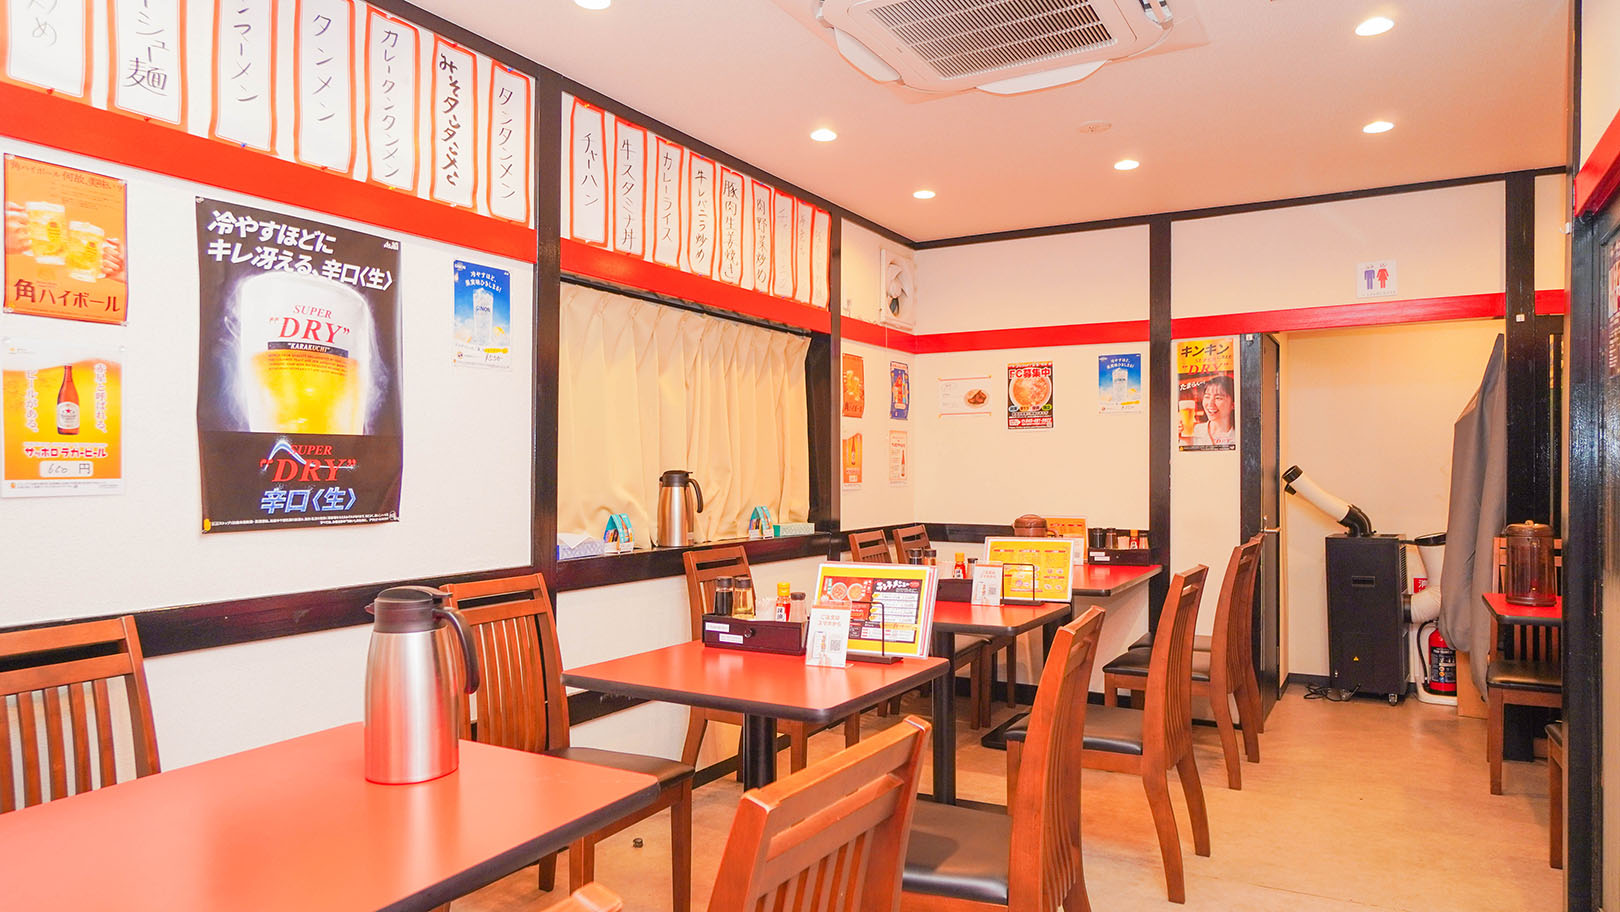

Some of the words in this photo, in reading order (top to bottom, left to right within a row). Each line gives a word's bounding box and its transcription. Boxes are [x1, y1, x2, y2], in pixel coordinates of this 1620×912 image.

[313, 14, 336, 122] タンメン
[439, 53, 461, 186] みそタンタンメン
[498, 87, 516, 199] タンタンメン
[580, 132, 599, 207] チャーハン
[619, 139, 637, 250] 牛スタミナ丼
[661, 152, 673, 242] カレーライス
[207, 209, 337, 254] 冷やすほどに
[207, 239, 393, 291] キレ冴える、辛口〈生〉
[14, 279, 121, 312] 角ハイボール
[293, 304, 333, 319] SUPER
[1181, 344, 1229, 357] キンキン
[1009, 367, 1050, 379] FC募集中
[25, 447, 58, 458] サッポロ
[61, 447, 107, 458] ラガービール
[79, 462, 91, 475] 円
[288, 444, 333, 456] SUPER
[260, 486, 357, 514] 辛口〈生〉
